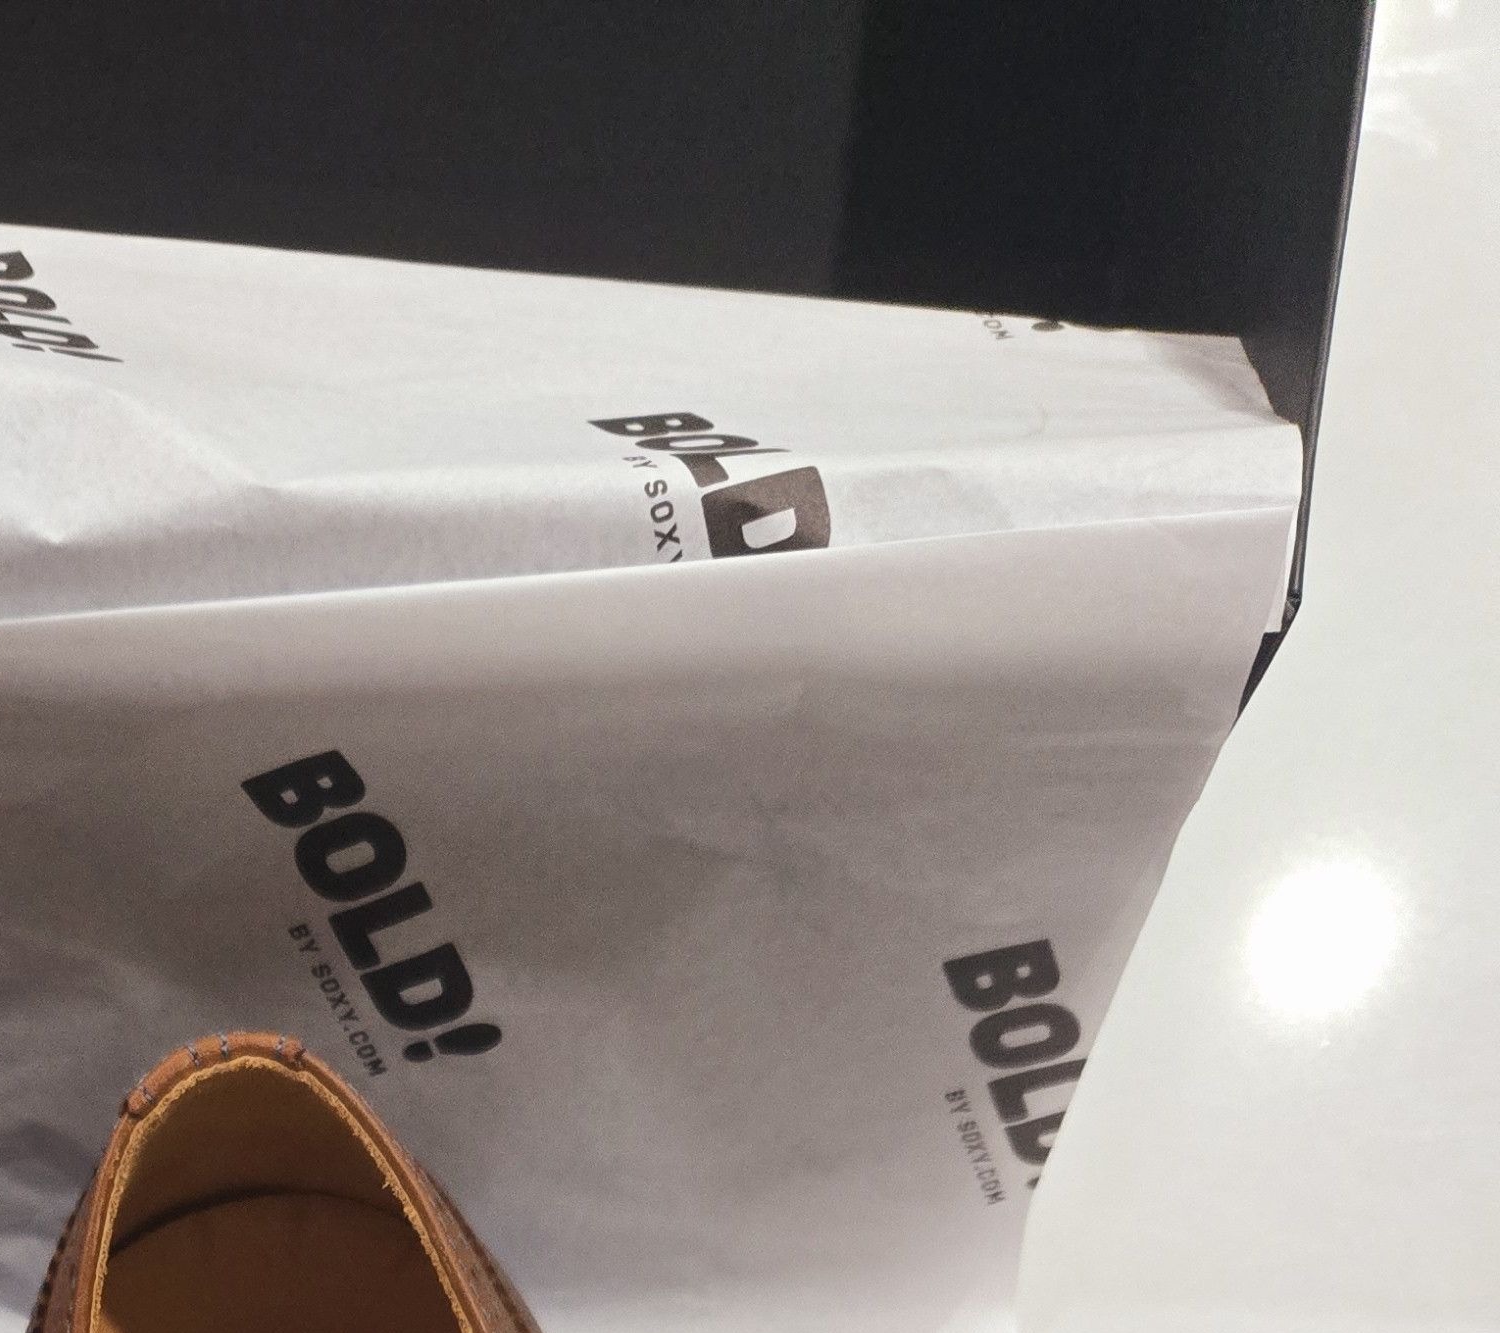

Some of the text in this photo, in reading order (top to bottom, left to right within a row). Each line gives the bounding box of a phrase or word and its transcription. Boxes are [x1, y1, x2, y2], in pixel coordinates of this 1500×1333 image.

[241, 749, 502, 1063] BOLD!
[288, 922, 388, 1078] BY SOXY.COM
[945, 1088, 1005, 1206] BY SOXY.COM
